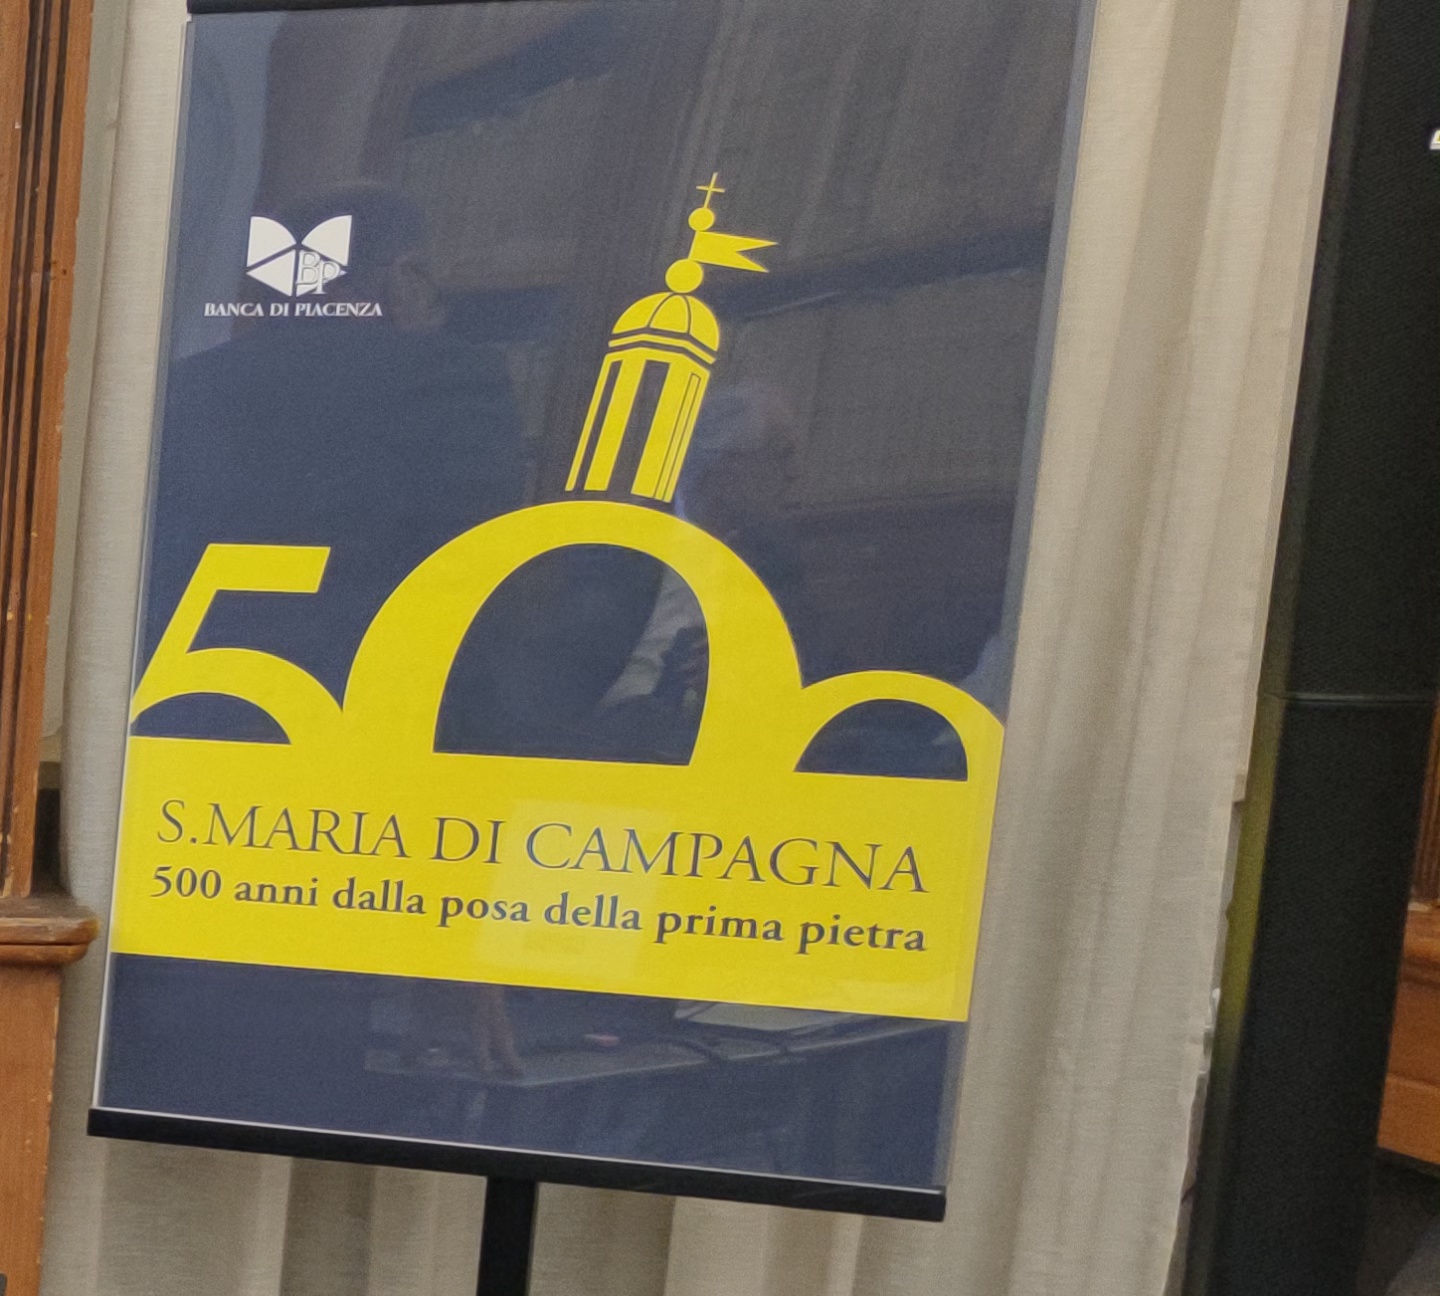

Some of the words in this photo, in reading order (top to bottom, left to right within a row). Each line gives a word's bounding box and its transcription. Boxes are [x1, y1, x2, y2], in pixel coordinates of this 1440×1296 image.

[203, 302, 264, 317] BANCA
[269, 302, 290, 317] DI
[294, 302, 384, 317] PIACENZA
[156, 798, 412, 860] S.MARIA
[429, 814, 506, 865] DI
[525, 821, 930, 895] CAMPAGNA
[150, 865, 223, 900] 500
[233, 876, 320, 908] anni
[332, 875, 428, 916] dalla
[436, 894, 532, 928] posa
[543, 890, 643, 932] della
[653, 904, 785, 945] prima
[795, 914, 928, 956] pietra
